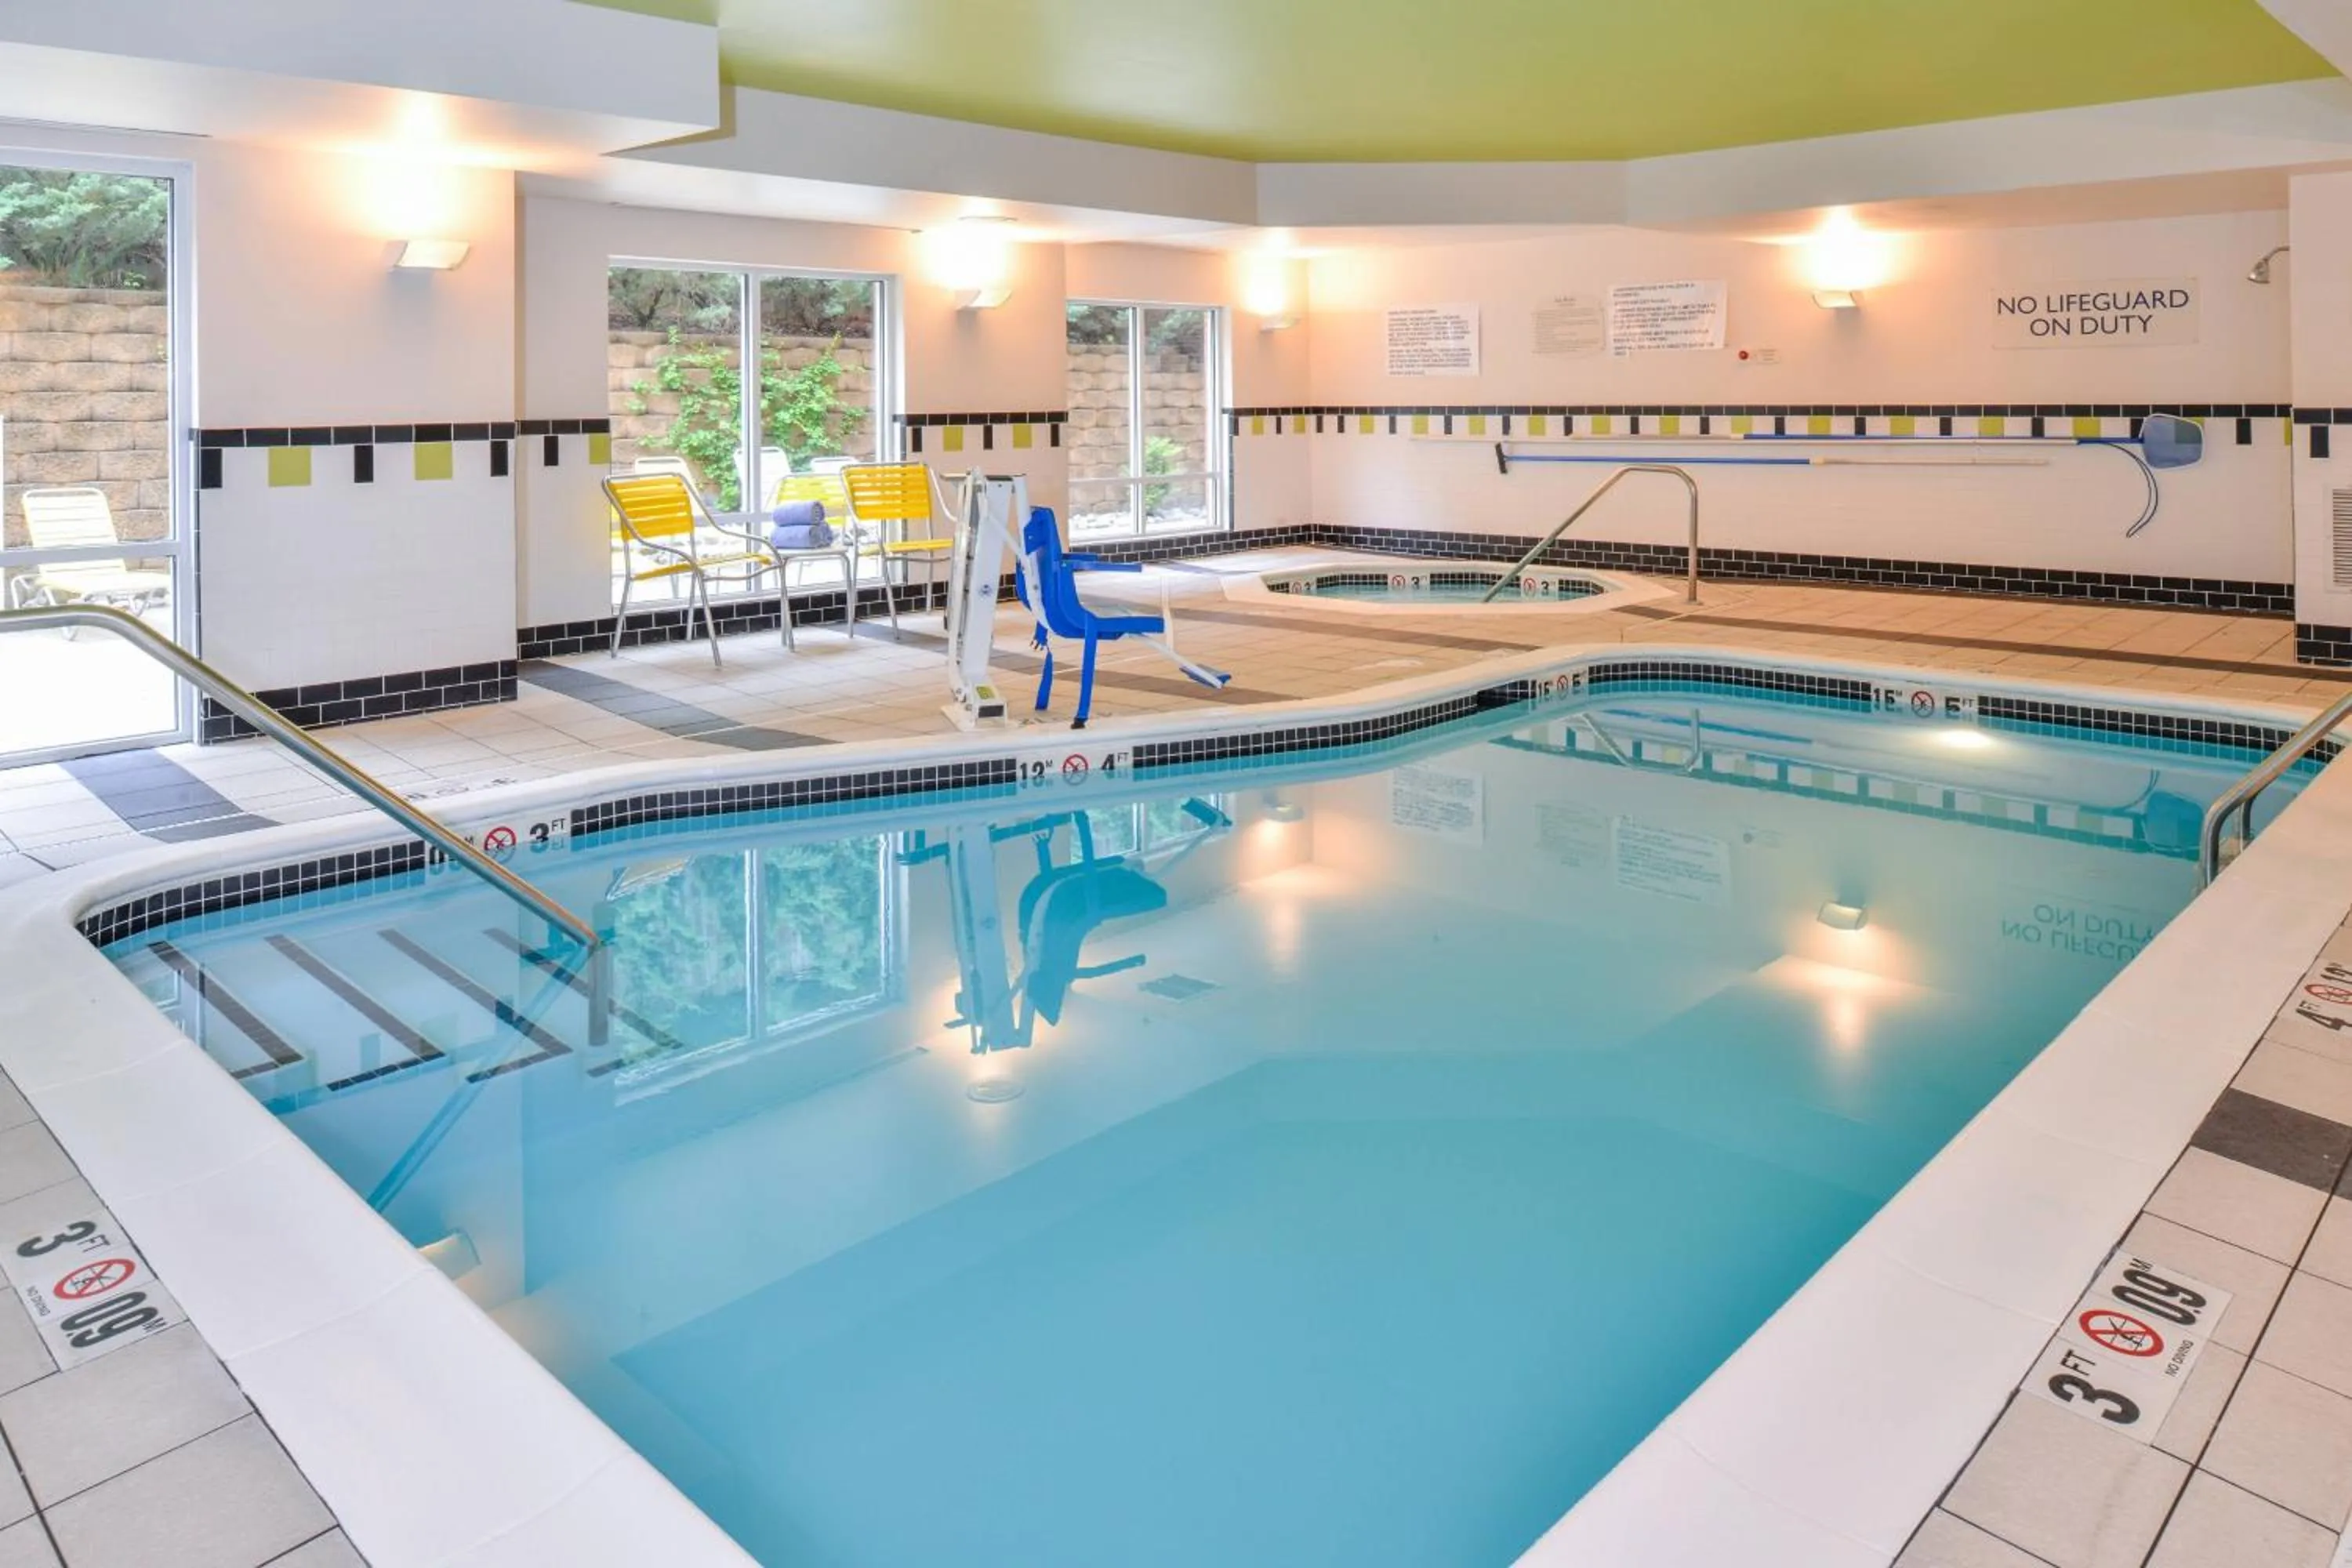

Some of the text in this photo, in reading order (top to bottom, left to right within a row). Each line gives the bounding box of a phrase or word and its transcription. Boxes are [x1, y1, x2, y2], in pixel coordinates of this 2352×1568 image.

[1998, 289, 2189, 315] NO LIFEGUARD
[2030, 314, 2153, 336] ON DUTY
[551, 818, 565, 831] FT
[16, 1221, 111, 1258] 3 FT
[2048, 1349, 2141, 1425] 3 FT
